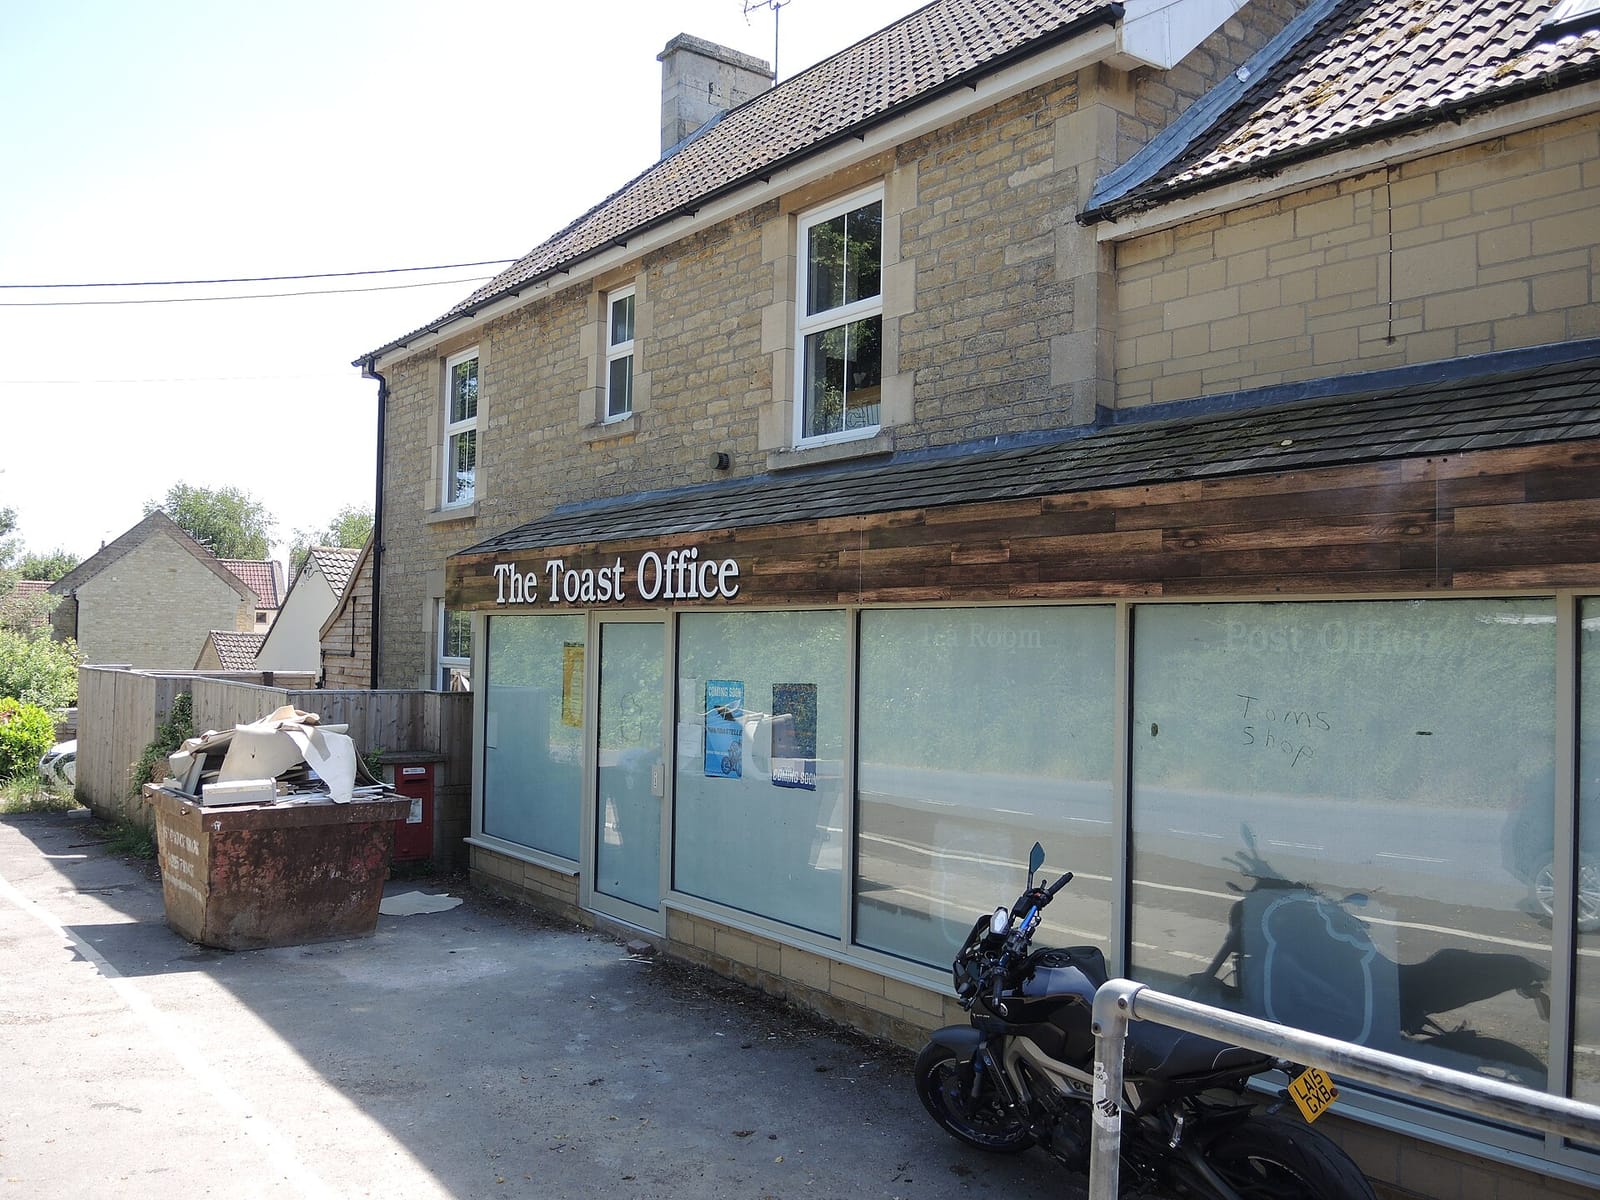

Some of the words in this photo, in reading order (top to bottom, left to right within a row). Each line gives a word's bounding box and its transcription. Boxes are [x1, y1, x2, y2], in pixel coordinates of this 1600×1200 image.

[494, 562, 538, 604] The
[545, 556, 626, 603] Toast
[637, 546, 740, 601] Office
[918, 622, 960, 647] Tea
[967, 622, 1043, 649] Room
[1225, 619, 1303, 652] Post
[1319, 618, 1435, 654] Office
[1236, 694, 1331, 731] Toms
[1242, 726, 1314, 767] Shop
[1293, 1067, 1323, 1100] LA15
[1305, 1084, 1331, 1114] GXB
